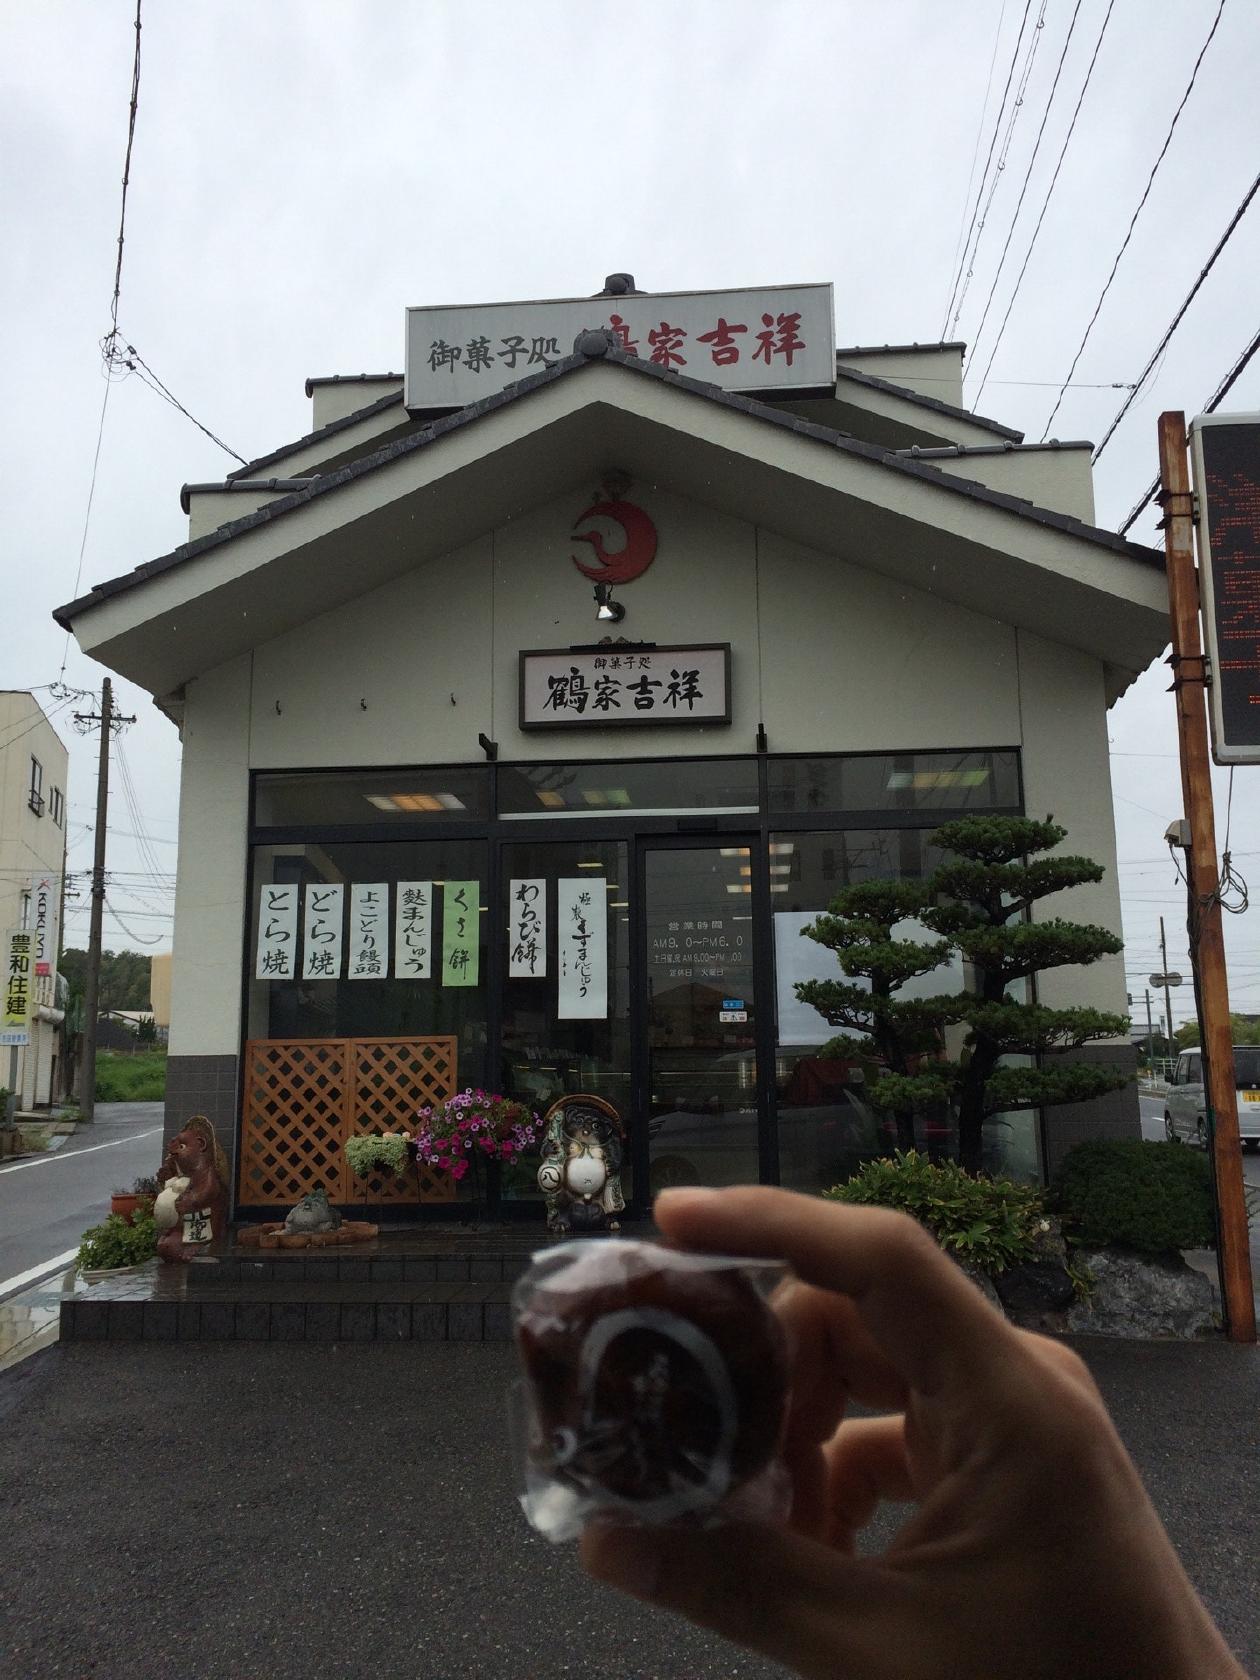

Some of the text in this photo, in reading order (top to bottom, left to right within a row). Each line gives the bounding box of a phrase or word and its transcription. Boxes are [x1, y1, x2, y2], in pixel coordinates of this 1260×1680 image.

[427, 335, 562, 374] 御菓子処
[543, 667, 704, 714] 鶴家吉祥
[594, 656, 652, 670] 御菓子処
[262, 890, 291, 976] とら焼
[308, 889, 337, 976] どら焼
[354, 891, 382, 975] よこどり饅頭
[449, 888, 470, 981] くさ餅
[511, 883, 542, 975] わらび餅
[668, 920, 723, 931] 営業時間
[6, 934, 31, 1016] 豊和住建
